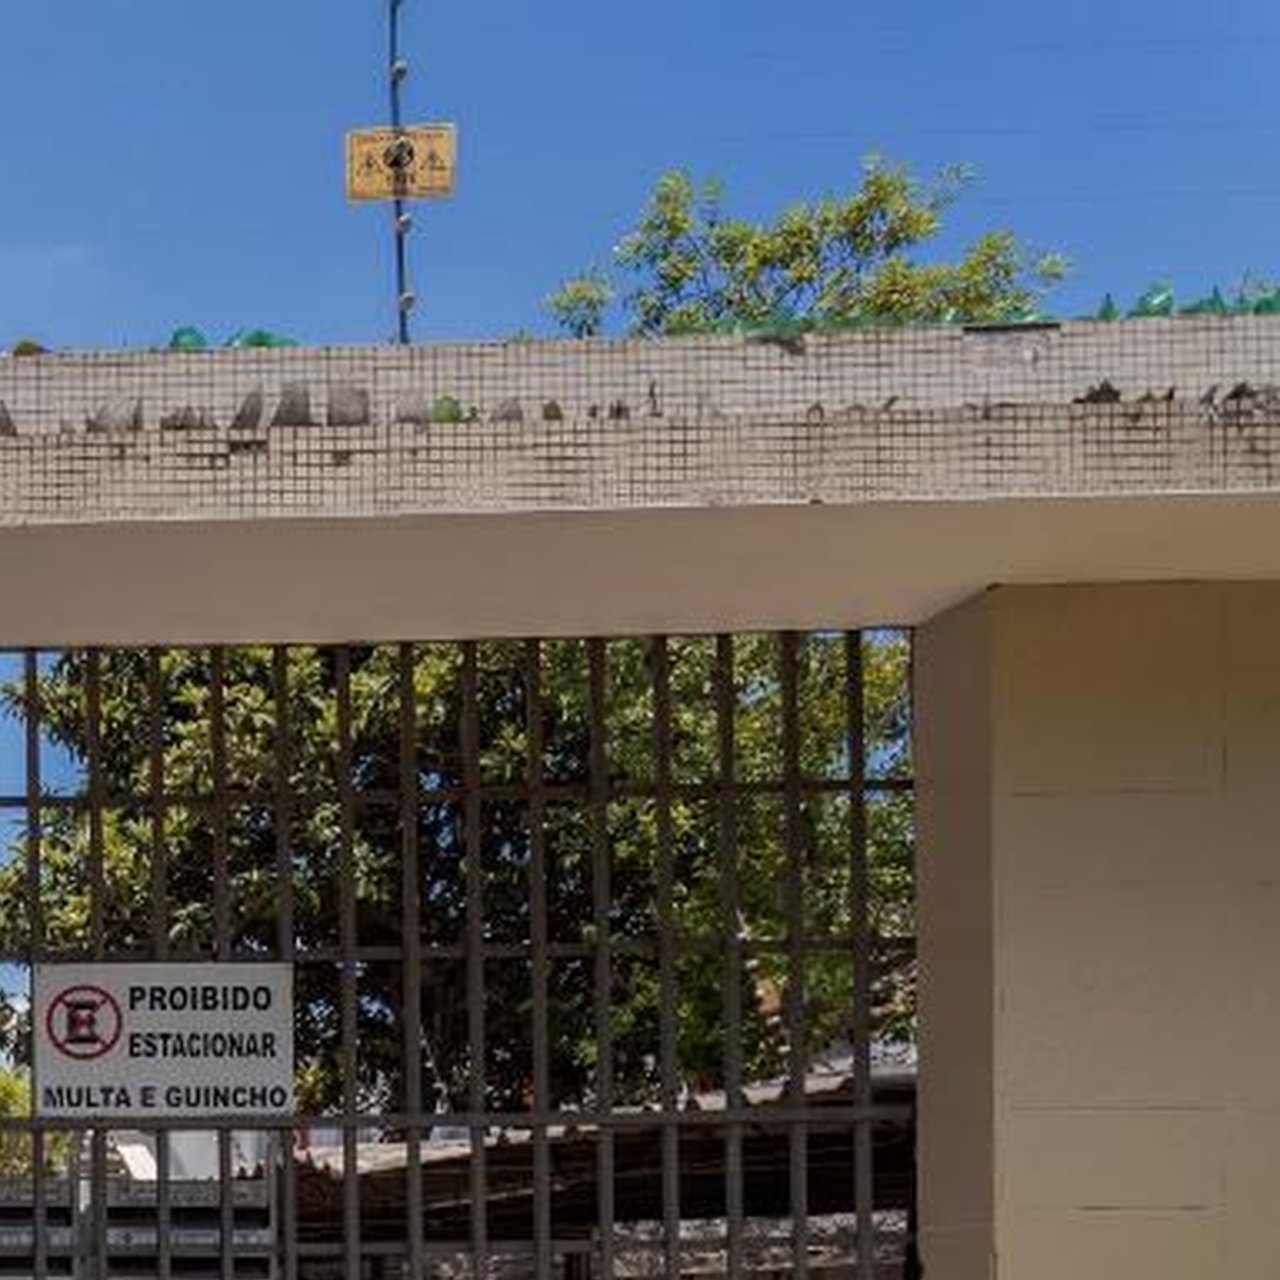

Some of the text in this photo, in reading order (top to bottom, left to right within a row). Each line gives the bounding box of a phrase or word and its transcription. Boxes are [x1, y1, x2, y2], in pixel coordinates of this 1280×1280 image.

[128, 986, 272, 1011] PROIBIDO
[128, 1033, 278, 1058] ESTACIONAR
[44, 1086, 288, 1108] MULTA E GUINCHO
